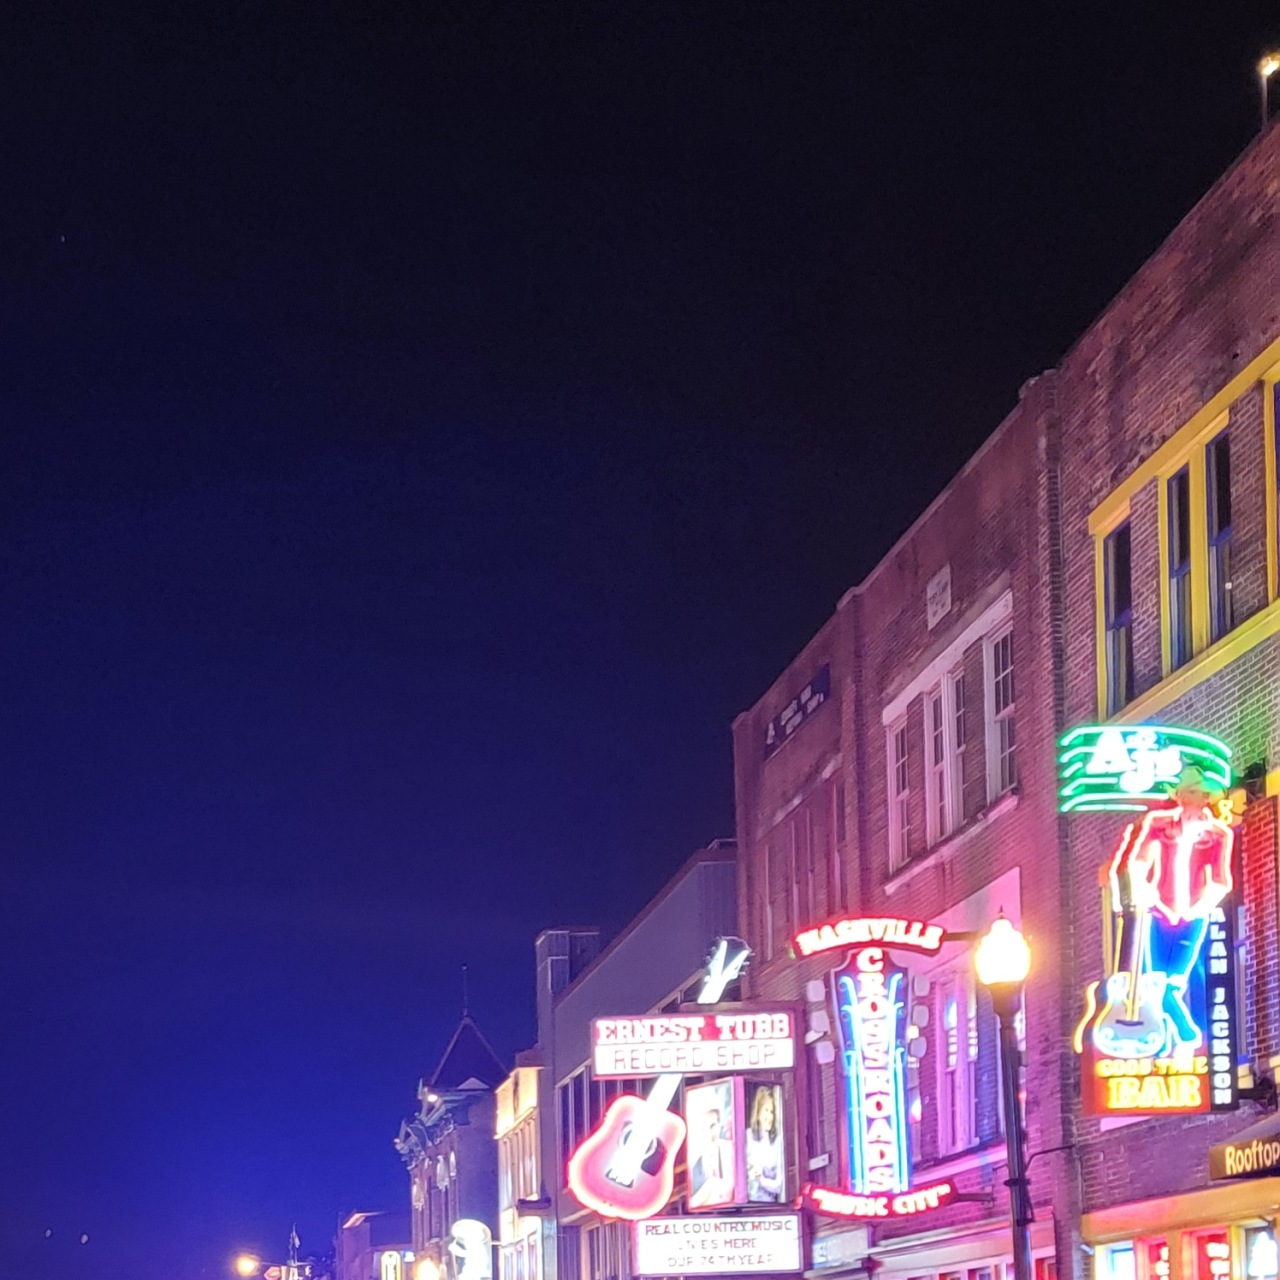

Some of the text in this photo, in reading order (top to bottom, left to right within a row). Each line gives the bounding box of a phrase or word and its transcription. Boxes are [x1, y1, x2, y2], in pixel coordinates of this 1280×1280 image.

[795, 917, 944, 956] NASHVILLE
[1209, 907, 1232, 1105] ALAN JACKSON
[597, 1012, 790, 1044] ERNEST TUBB
[613, 1044, 776, 1070] RECORD SHOP
[855, 948, 896, 1192] CROSSROADS
[1107, 1075, 1202, 1109] BAR
[1225, 1139, 1280, 1175] Rooftop
[645, 1219, 793, 1236] REAL COUNTRY MUSIC
[723, 1237, 758, 1249] HERE
